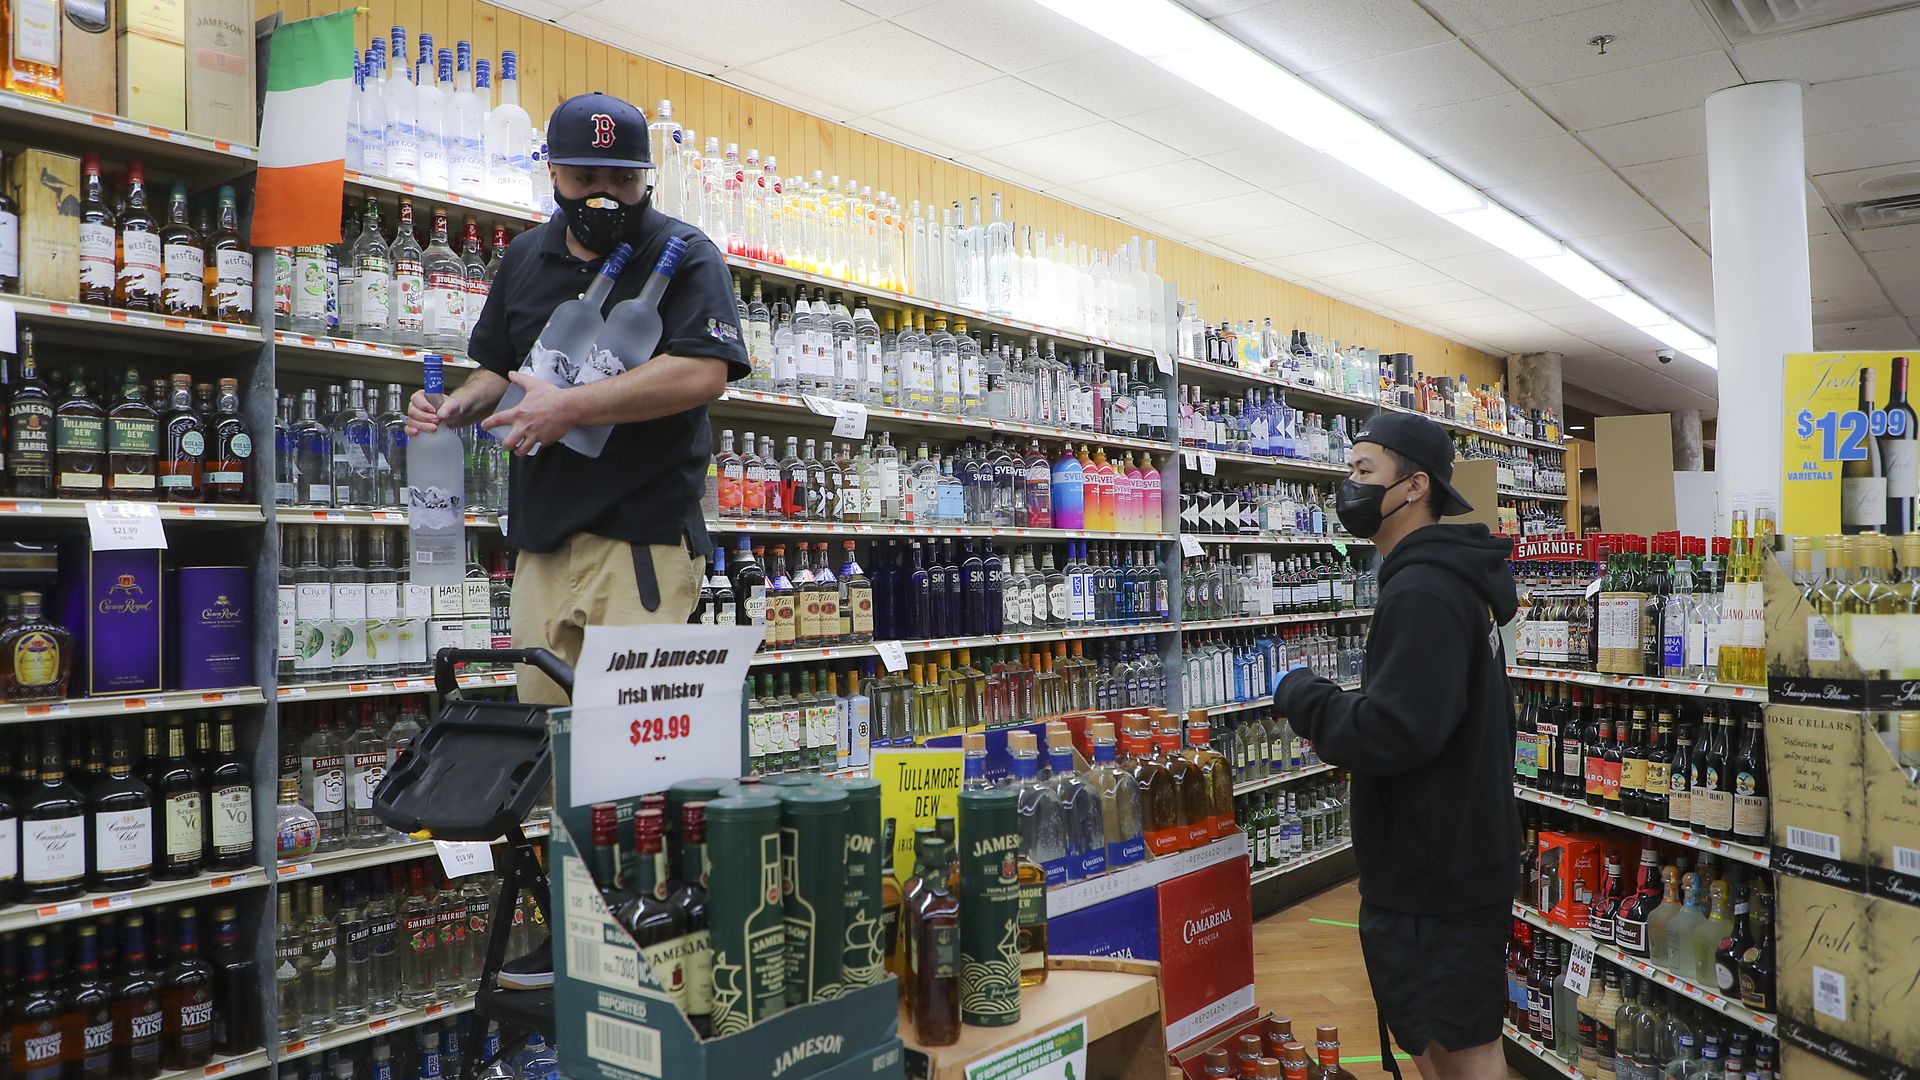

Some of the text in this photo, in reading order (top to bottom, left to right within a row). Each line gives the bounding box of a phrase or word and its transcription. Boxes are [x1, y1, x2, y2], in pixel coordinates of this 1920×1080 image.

[197, 17, 243, 36] JAMESON
[592, 114, 615, 148] B
[9, 404, 54, 418] JAMESON
[62, 419, 103, 430] TULLAMORE
[115, 421, 155, 431] TULLAMORE
[20, 431, 47, 440] BLACK
[127, 430, 143, 438] DEW
[18, 442, 49, 452] BARREL
[1803, 462, 1818, 470] ALL
[1788, 472, 1833, 481] VARIETALS
[1518, 542, 1584, 558] SMIRNOFF
[99, 600, 154, 614] Crown Royal
[202, 609, 221, 620] Crown
[606, 648, 728, 672] John Jameson
[618, 681, 704, 706] Irish Whiskey
[1782, 682, 1851, 701] Sauvignon Blanc
[630, 714, 690, 746] $29.99
[1798, 720, 1853, 732] CELLARS
[1784, 736, 1818, 749] Distinctive
[1784, 753, 1832, 766] unforgettable
[1797, 766, 1808, 776] like
[1794, 780, 1828, 793] Dad Josh
[916, 796, 941, 818] DEW
[227, 810, 248, 824] VO
[108, 820, 146, 832] Canadian
[1217, 819, 1234, 830] CAMARENA
[36, 829, 76, 842] Canadian
[120, 831, 138, 842] Club
[1190, 828, 1208, 840] CAMARENA
[46, 841, 66, 852] Club
[898, 838, 915, 853] IRIS
[1156, 835, 1178, 848] CAMARENA
[1122, 844, 1144, 858] CAMARENA
[1189, 848, 1220, 864] REPOSADO
[1082, 855, 1105, 870] CAMARENA
[1780, 854, 1851, 883] Sauvignon Blanc
[1183, 908, 1232, 944] CAMARENA
[1198, 932, 1220, 946] TEQUILA
[1090, 944, 1111, 955] FAMILIA
[599, 994, 646, 1018] IMPORTED
[181, 1009, 213, 1028] MIST
[1194, 1002, 1226, 1025] REPOSADO
[1787, 1024, 1858, 1066] Sauvignon Blanc
[772, 1034, 844, 1078] JAMESON
